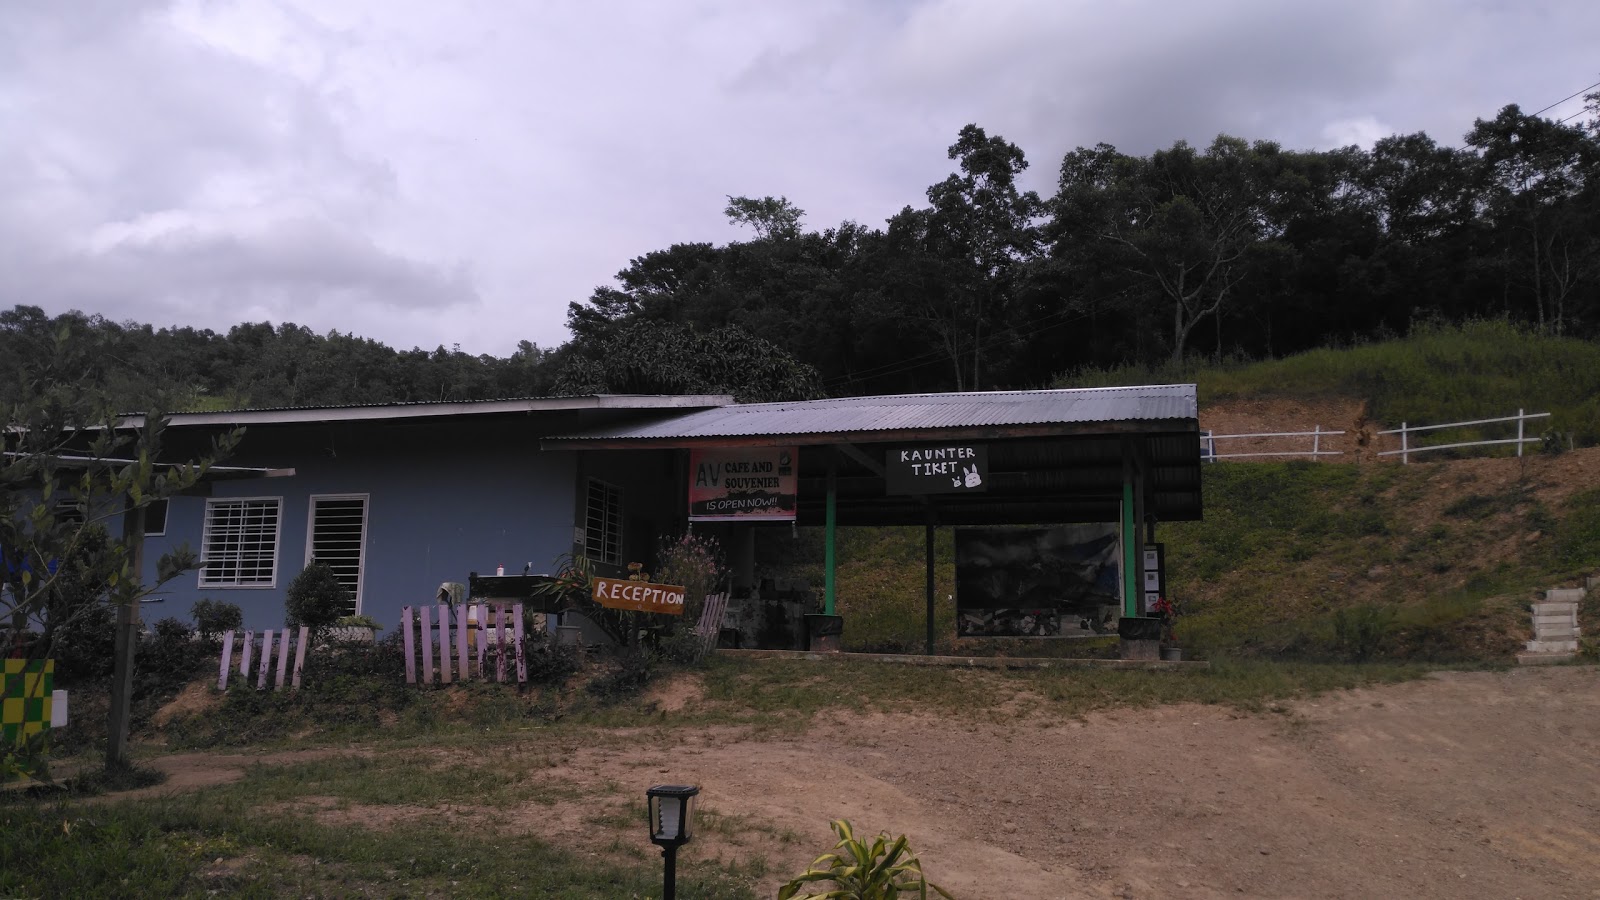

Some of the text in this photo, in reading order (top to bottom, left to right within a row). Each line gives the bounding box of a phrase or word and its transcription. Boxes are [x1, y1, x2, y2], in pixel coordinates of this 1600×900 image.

[901, 447, 976, 462] KAUNTER
[696, 464, 720, 486] AV
[725, 462, 750, 473] CAFE
[752, 461, 772, 473] AND
[911, 461, 958, 476] TIKET
[725, 477, 779, 488] SOUVENIER
[706, 497, 778, 510] IS OPEN NOW!!
[596, 581, 685, 605] RECEPTION
